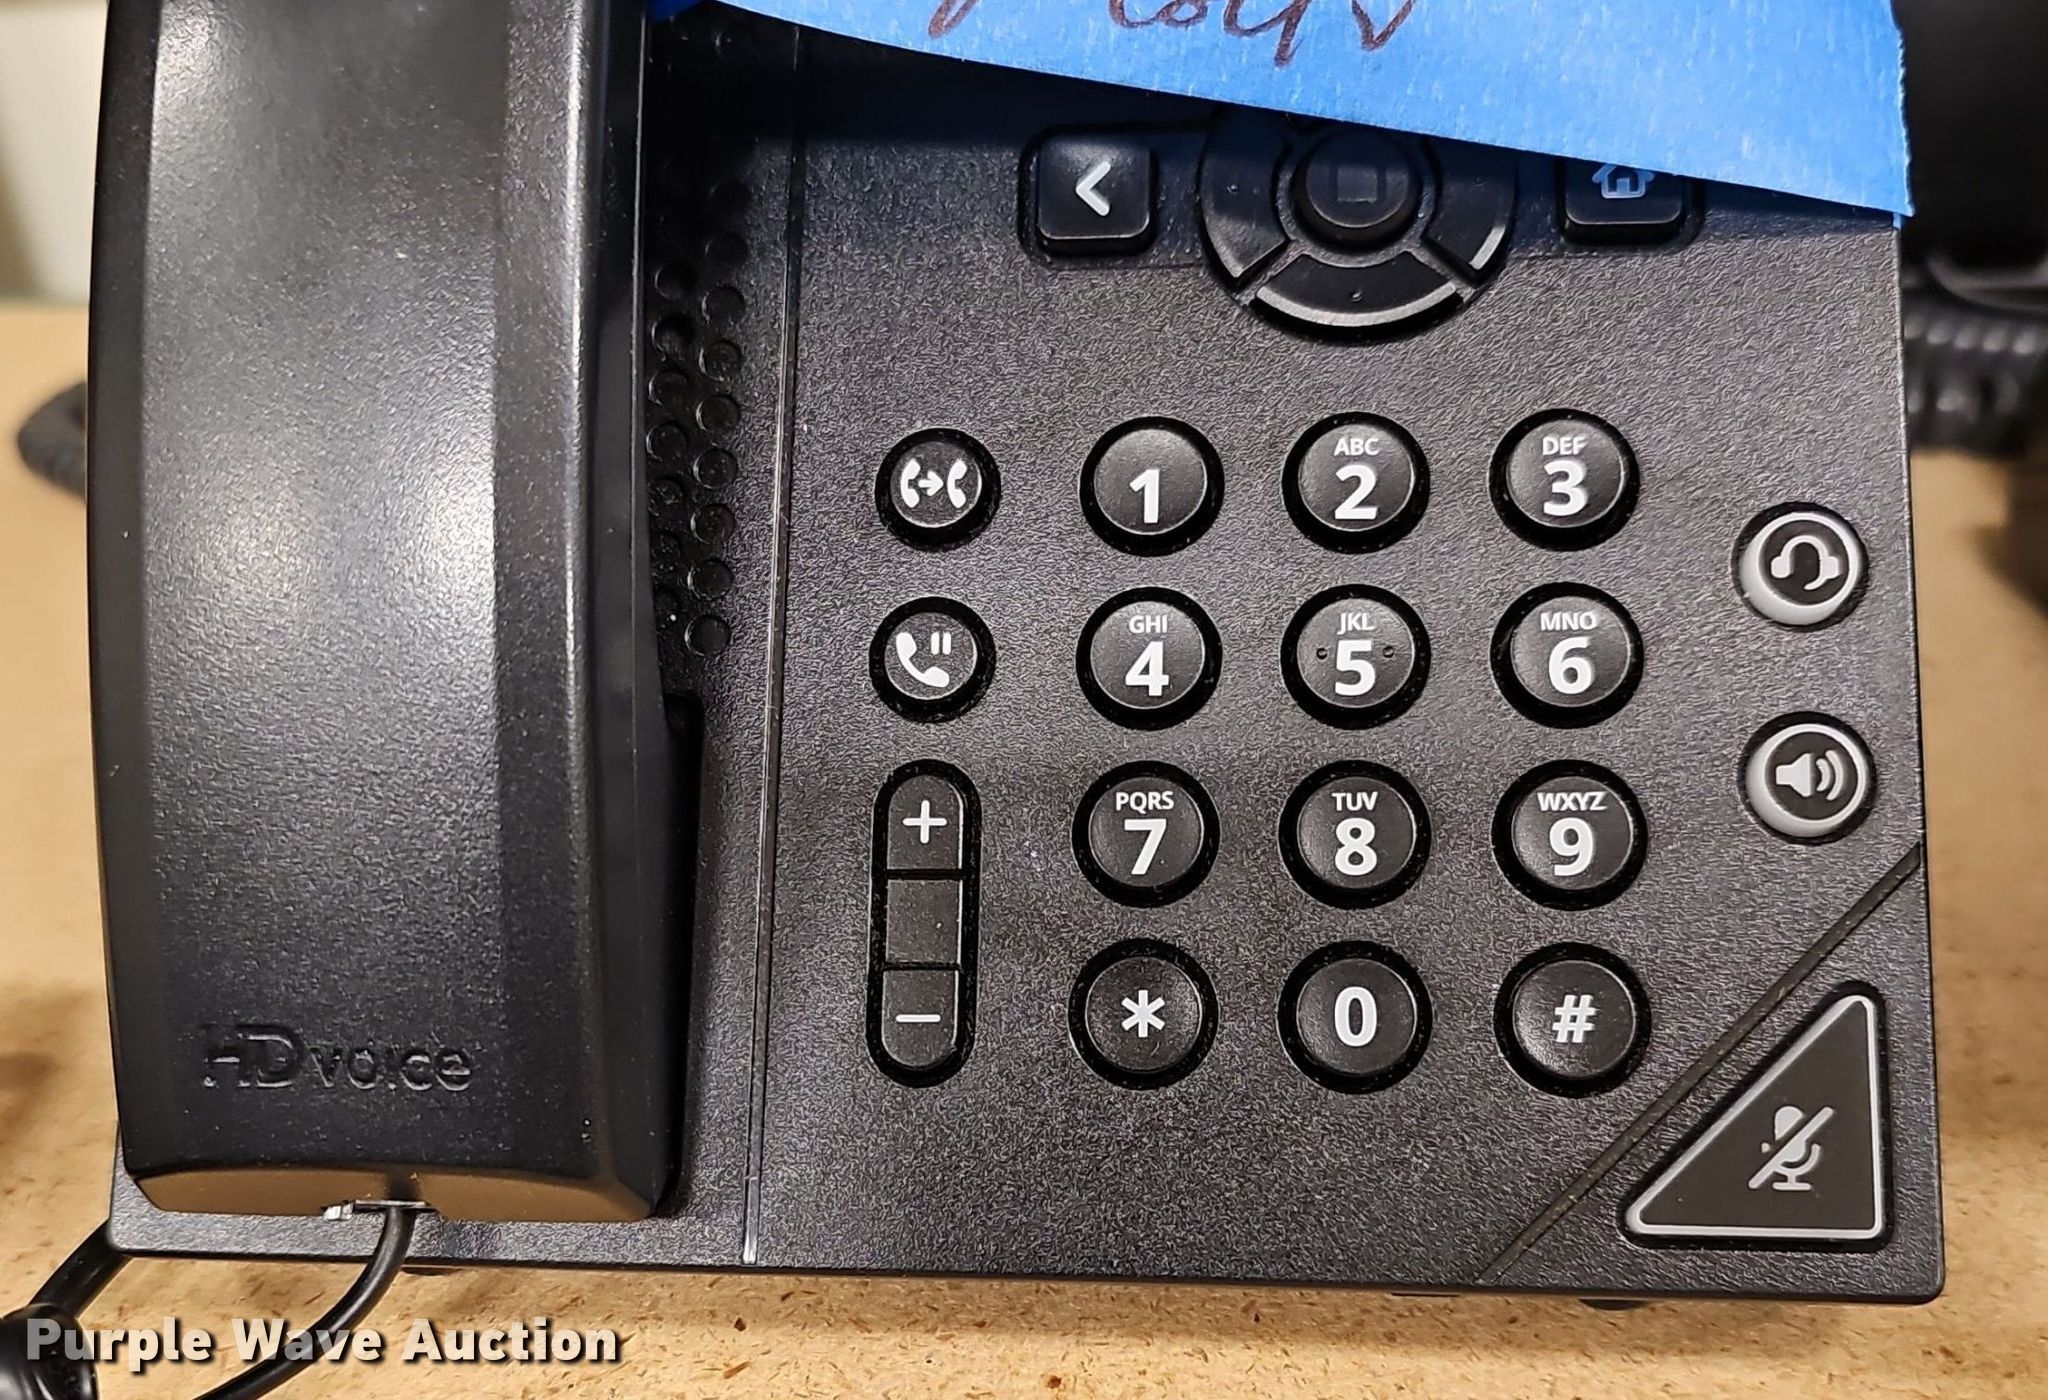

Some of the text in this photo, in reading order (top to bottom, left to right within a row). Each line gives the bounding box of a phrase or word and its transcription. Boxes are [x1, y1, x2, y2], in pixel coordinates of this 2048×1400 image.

[1333, 436, 1380, 457] ABC
[1541, 435, 1588, 456] DEF
[1129, 468, 1160, 524] 1
[1334, 461, 1378, 520] 2
[1543, 458, 1588, 516] 3
[1127, 613, 1170, 635] GHI
[1336, 612, 1376, 634] JKL
[1539, 611, 1598, 631] MNO
[1125, 640, 1170, 696] 4
[1334, 637, 1376, 696] 5
[1548, 635, 1594, 695] 6
[1115, 790, 1175, 813] PQRS
[1331, 791, 1378, 811] TUV
[1537, 791, 1607, 811] WXYZ
[1124, 818, 1167, 875] 7
[1334, 817, 1378, 876] 8
[1549, 817, 1594, 876] 9
[1334, 986, 1377, 1047] 0
[1551, 994, 1598, 1044] #
